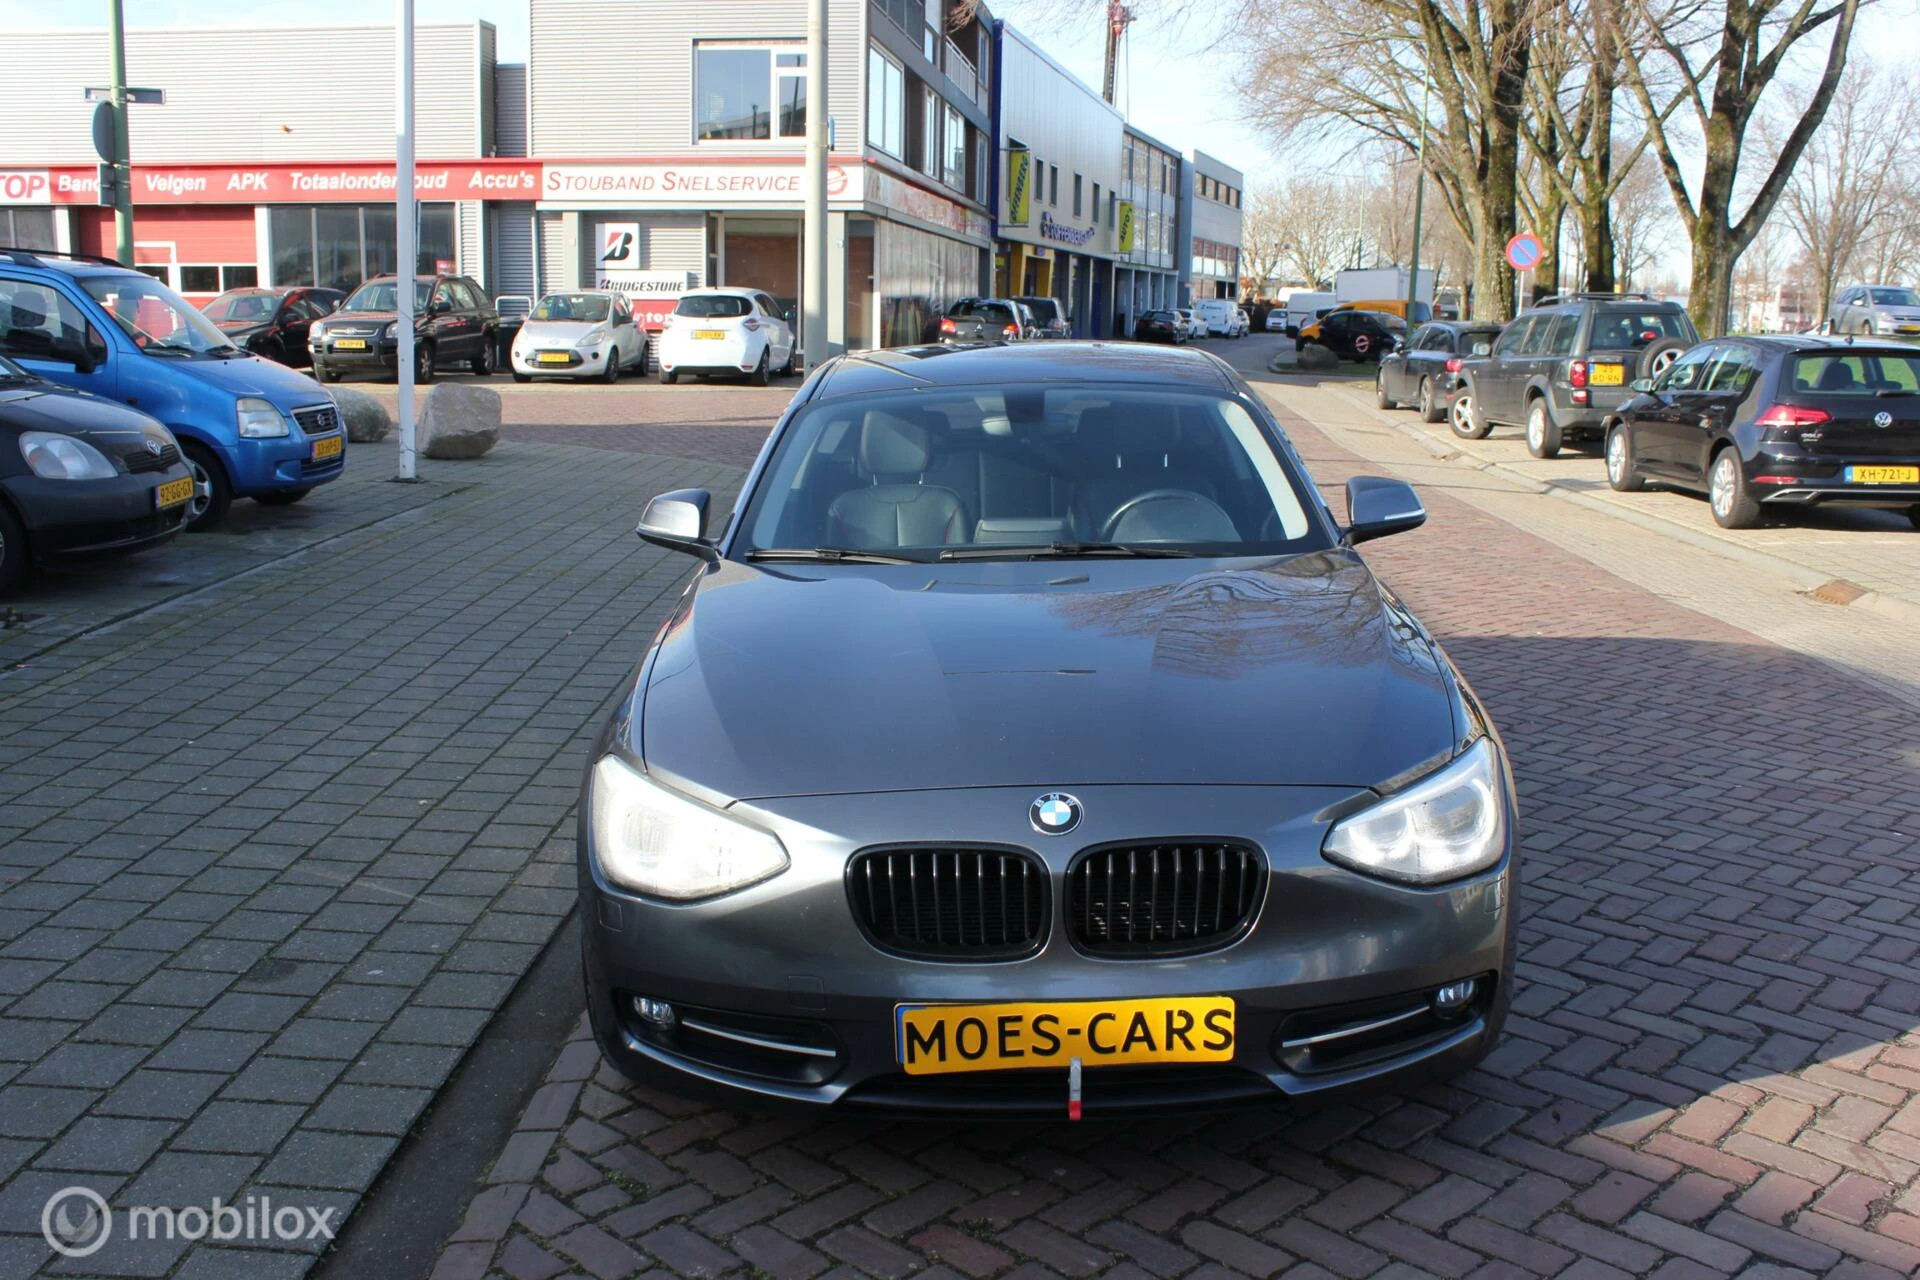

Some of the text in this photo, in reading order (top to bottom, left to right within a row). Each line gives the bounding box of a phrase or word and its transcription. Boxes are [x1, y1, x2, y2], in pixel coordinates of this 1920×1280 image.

[145, 174, 207, 196] Velgen
[227, 173, 269, 191] APK
[290, 171, 449, 190] Totaalonderoud
[468, 170, 536, 189] Accu's
[546, 170, 802, 192] STOUBAND SNELSERVICE
[600, 278, 685, 292] BRIDGESTONE
[1859, 468, 1912, 480] XH-721-J
[1033, 793, 1077, 808] BMW
[905, 1009, 1234, 1064] MOES-CARS
